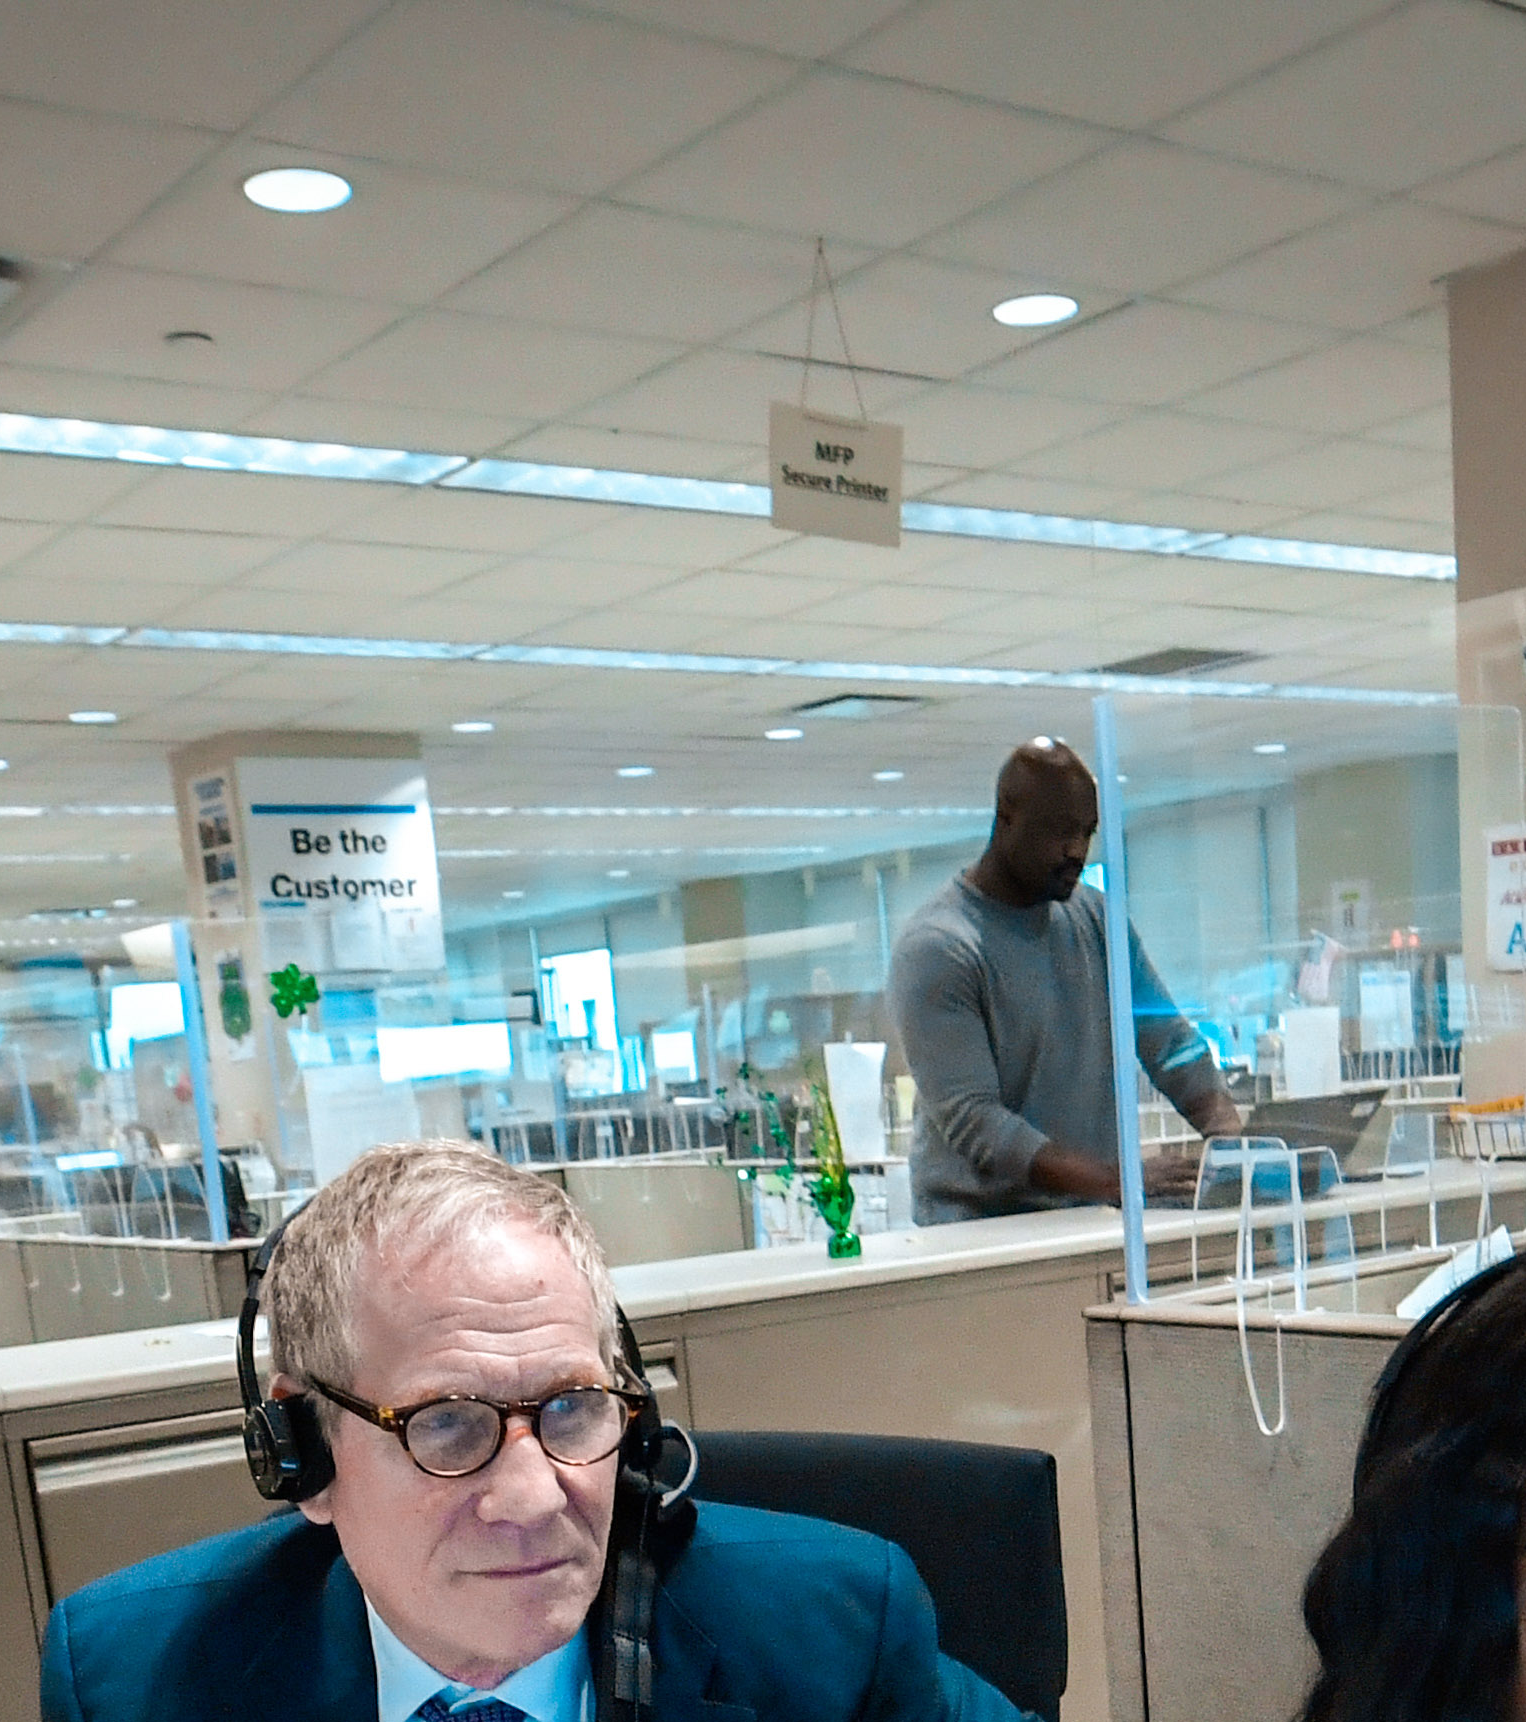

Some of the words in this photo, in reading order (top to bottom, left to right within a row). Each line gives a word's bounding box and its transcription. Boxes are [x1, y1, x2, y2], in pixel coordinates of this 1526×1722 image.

[782, 464, 832, 492] Secure
[836, 474, 889, 502] Printer
[290, 829, 331, 854] Be
[339, 828, 388, 854] the
[270, 874, 418, 901] Customer
